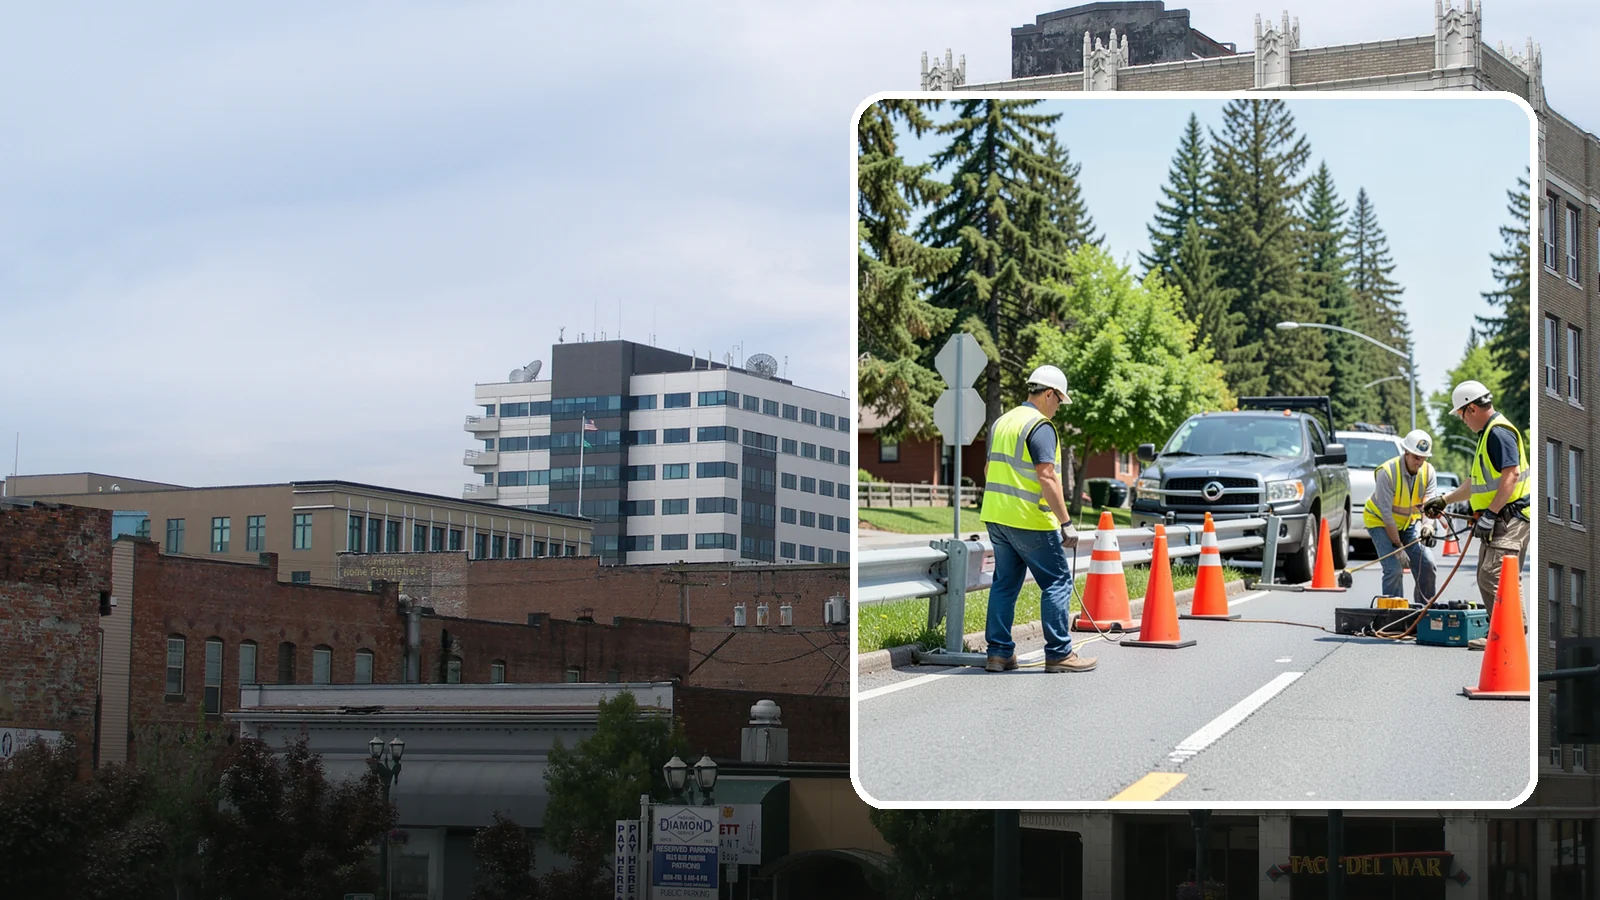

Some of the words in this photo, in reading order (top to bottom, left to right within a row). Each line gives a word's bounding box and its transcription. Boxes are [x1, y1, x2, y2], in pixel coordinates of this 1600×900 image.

[370, 566, 426, 577] Furnishers
[660, 818, 713, 833] DIAMOND
[1022, 814, 1069, 828] BUILDING
[617, 824, 625, 852] PAY
[628, 824, 637, 852] PAY
[656, 845, 688, 853] RESERVED
[721, 851, 739, 862] Soup
[671, 862, 701, 870] PATRONS
[1346, 856, 1386, 875] DEL
[1391, 857, 1443, 877] MAR
[616, 856, 625, 894] HERE
[627, 855, 636, 894] HERE
[660, 888, 682, 897] PUBLIC
[683, 889, 710, 899] PARKING
